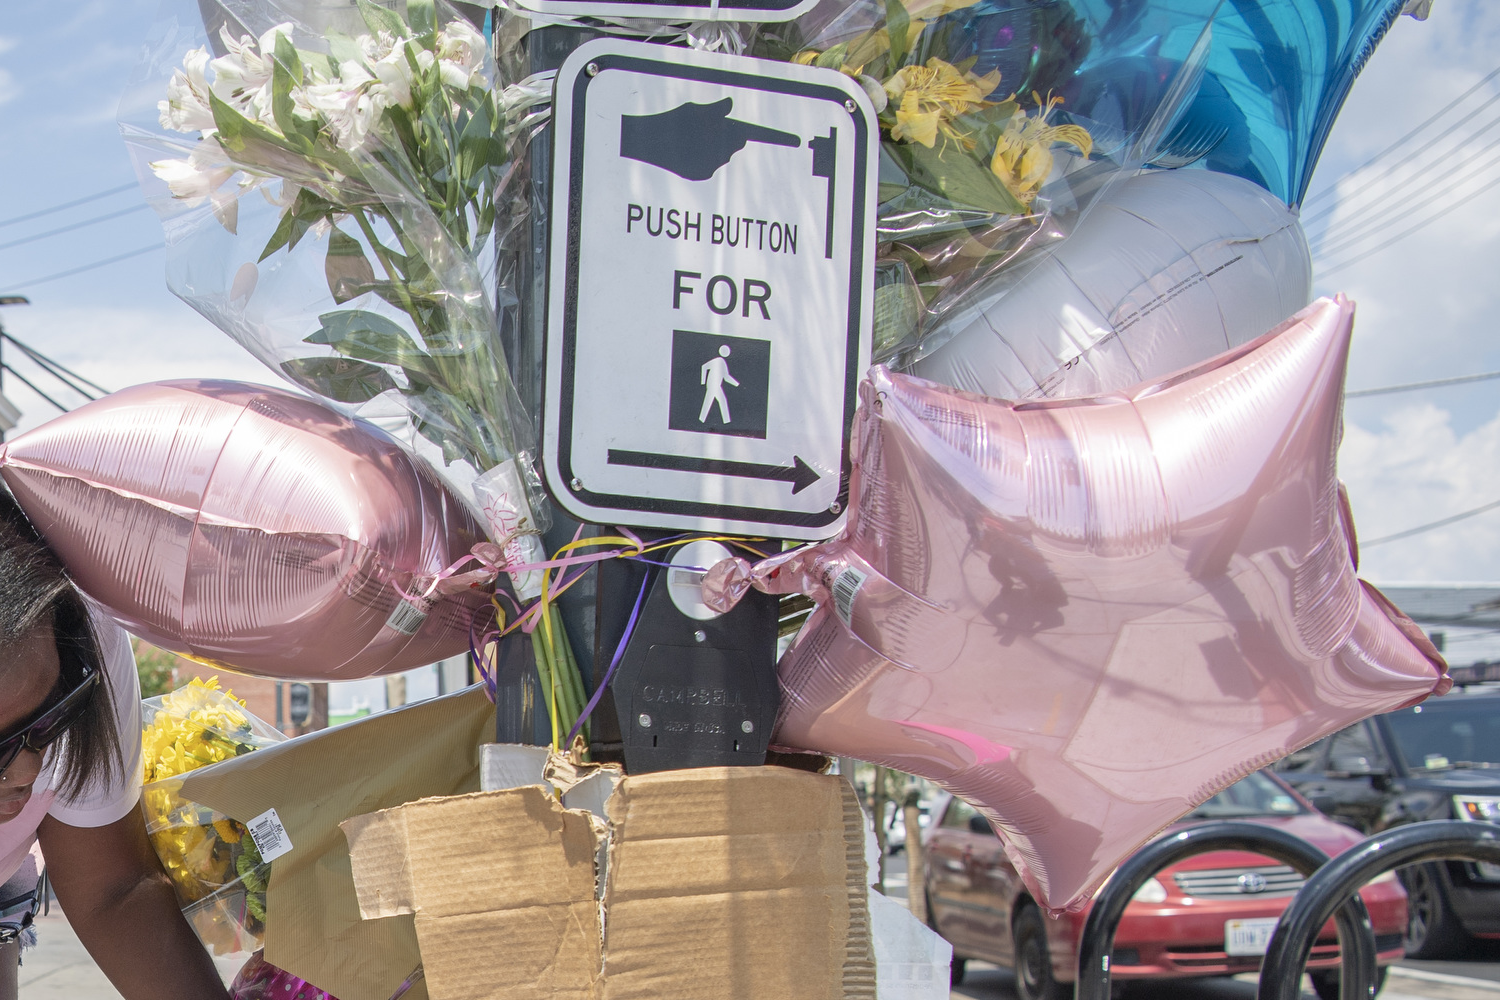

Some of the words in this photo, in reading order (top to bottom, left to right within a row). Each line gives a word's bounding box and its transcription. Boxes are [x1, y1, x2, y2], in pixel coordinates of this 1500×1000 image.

[627, 203, 701, 242] PUSH
[711, 213, 798, 255] BUTTON
[672, 269, 772, 320] FOR
[643, 685, 747, 708] CAMPBELL
